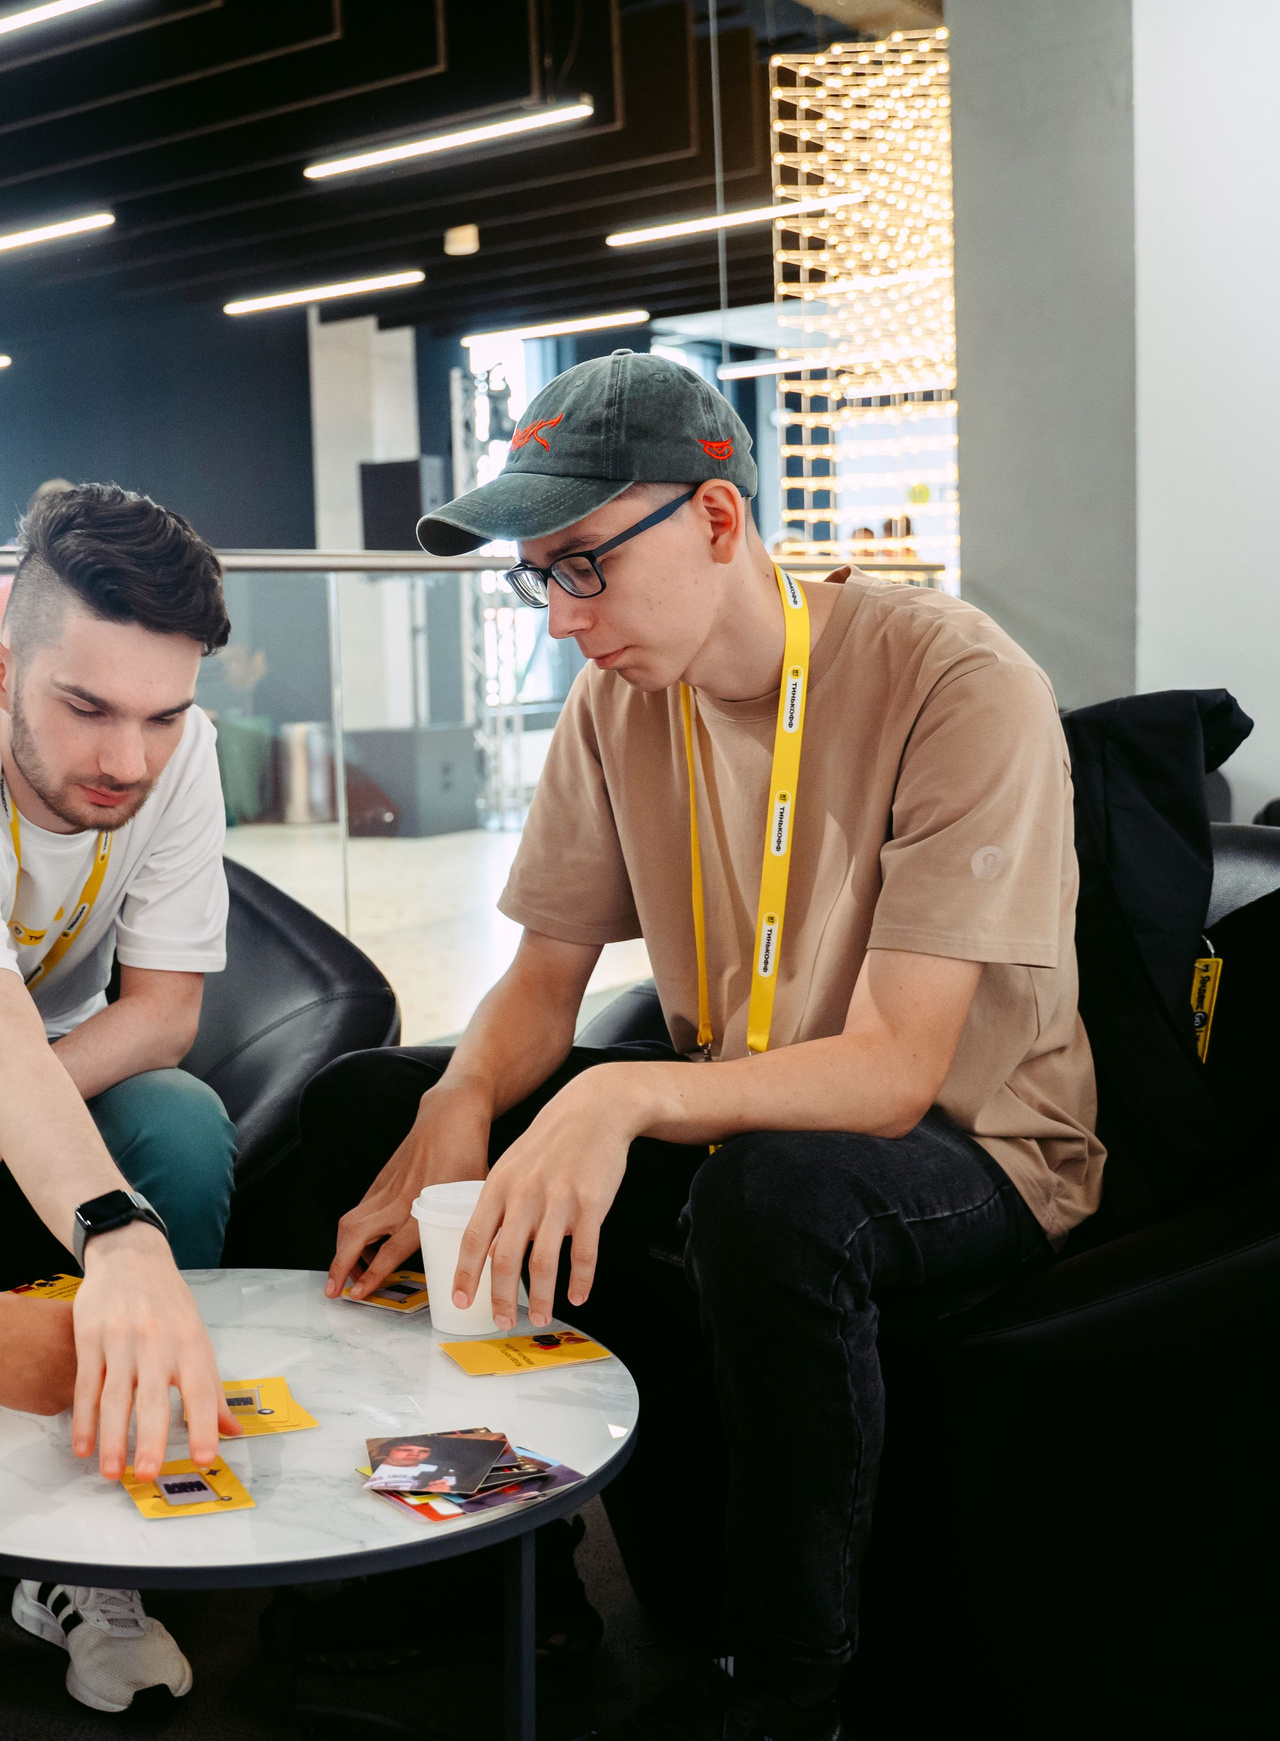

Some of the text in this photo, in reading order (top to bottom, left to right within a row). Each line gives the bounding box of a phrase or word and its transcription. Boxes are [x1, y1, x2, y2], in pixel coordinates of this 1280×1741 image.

[788, 682, 797, 729] ТИНЬКОФФ
[776, 806, 785, 852] ТИНЬКОФФ
[762, 929, 773, 973] ТИНЬКОФФ
